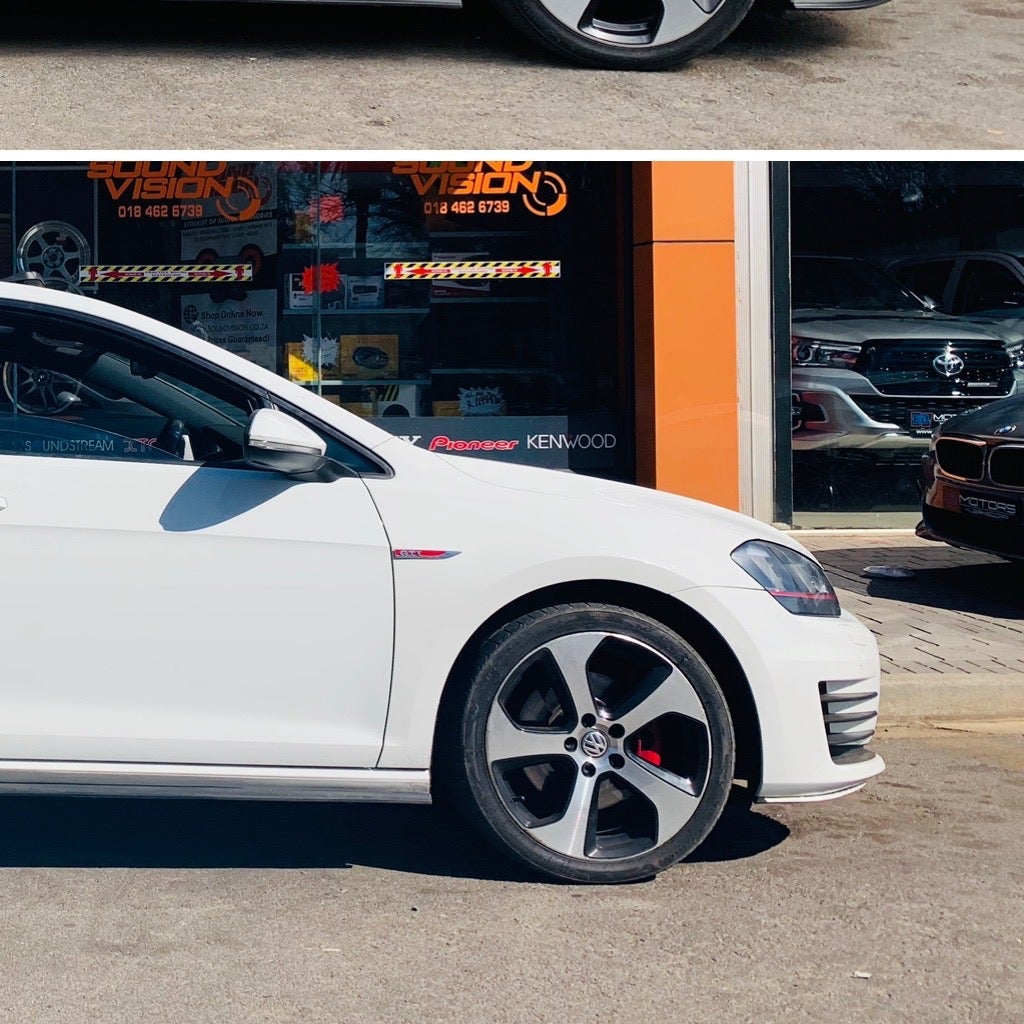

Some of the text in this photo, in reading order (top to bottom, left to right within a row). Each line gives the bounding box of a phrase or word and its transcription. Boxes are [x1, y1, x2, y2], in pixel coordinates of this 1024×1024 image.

[87, 161, 228, 179] SOUND
[392, 161, 534, 174] SOUND
[105, 177, 234, 200] VISION
[410, 171, 541, 195] VISION
[118, 204, 203, 218] 018 462 6739
[424, 200, 510, 214] 018 462 6739
[201, 308, 263, 321] Shop Online Now
[228, 335, 270, 343] Guaranteed!
[25, 439, 114, 452] SUNDSTREAM
[428, 436, 519, 451] Pioneer
[527, 434, 616, 449] KENWOOD
[959, 494, 1017, 514] MOTORS
